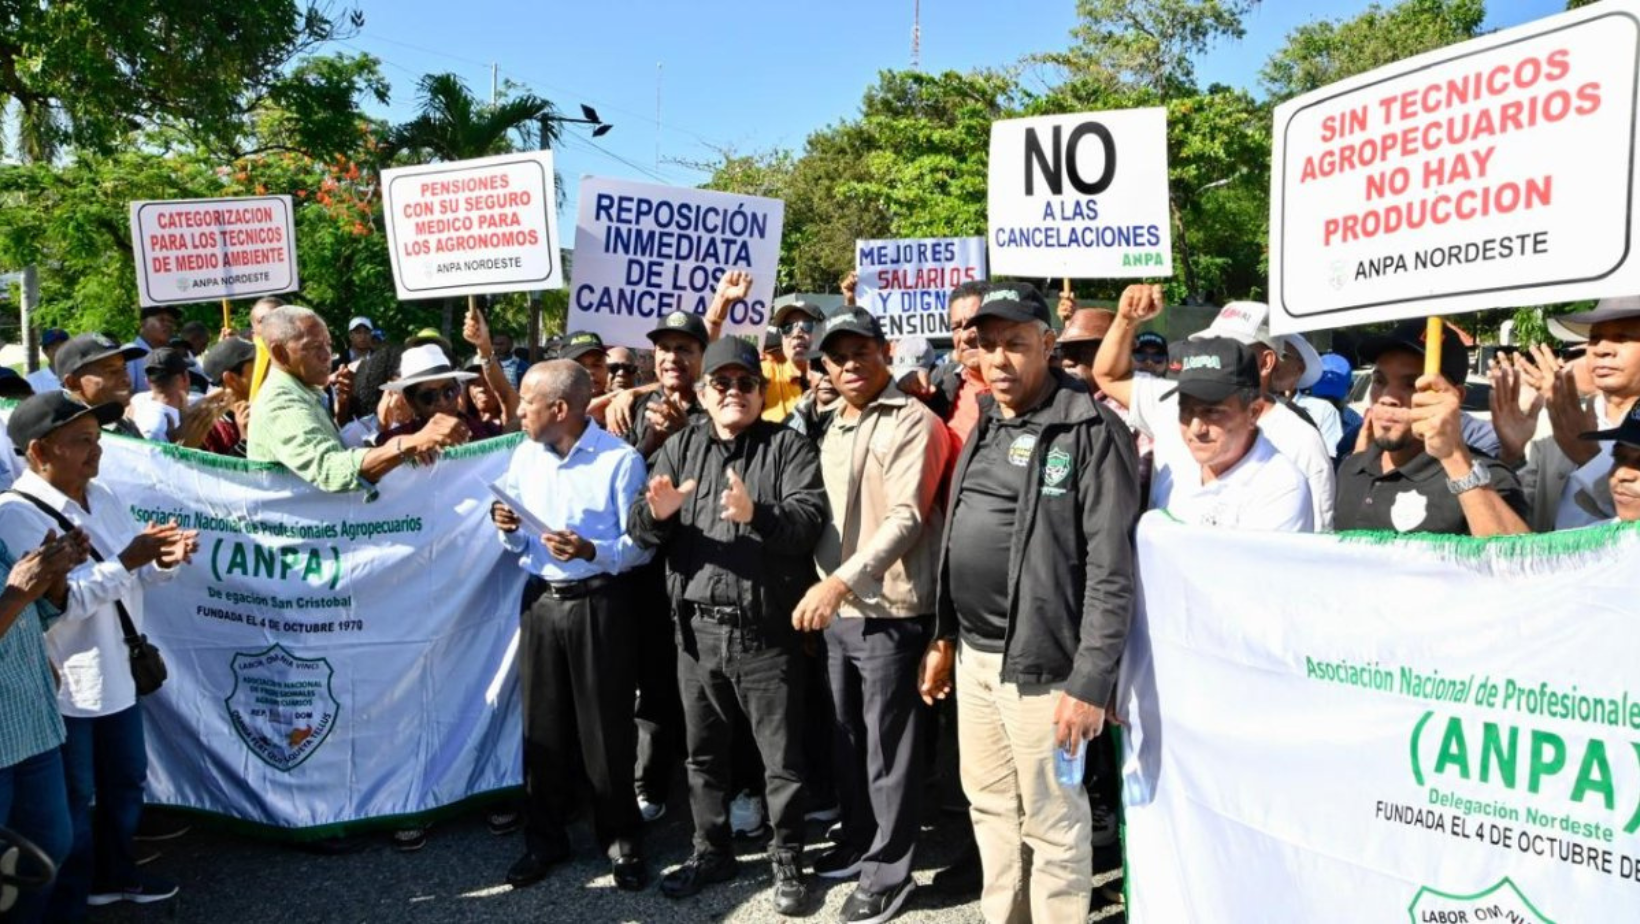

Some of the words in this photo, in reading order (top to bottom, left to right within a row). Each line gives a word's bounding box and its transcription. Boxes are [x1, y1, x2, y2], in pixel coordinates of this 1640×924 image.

[1320, 105, 1368, 143] SIN
[1379, 48, 1571, 125] TECNICOS
[1300, 82, 1602, 184] AGROPECUARIOS
[1024, 121, 1116, 196] NO
[420, 174, 510, 198] PENSIONES
[1365, 166, 1410, 201] NO
[1422, 146, 1496, 189] HAY
[403, 202, 434, 218] CON
[439, 199, 460, 214] SU
[464, 191, 532, 212] SEGURO
[595, 193, 768, 239] REPOSICIÓN
[1043, 200, 1056, 221] A
[1060, 199, 1098, 221] LAS
[1323, 175, 1552, 247] PRODUCCION
[157, 207, 273, 230] CATEGORIZACION
[415, 217, 473, 236] MEDICO
[478, 212, 521, 229] PARA
[150, 233, 188, 251] PARA
[191, 231, 218, 249] LOS
[220, 227, 283, 247] TECNICOS
[404, 240, 431, 257] LOS
[435, 230, 539, 254] AGRONOMOS
[604, 225, 753, 267] INMEDIATA
[995, 225, 1160, 248] CANCELACIONES
[152, 256, 172, 273] DE
[175, 253, 218, 271] MEDIO
[223, 247, 285, 268] AMBIENTE
[436, 262, 462, 274] ANPA
[464, 256, 522, 271] NORDESTE
[859, 242, 956, 266] MEJORES
[1122, 252, 1164, 267] ANPA
[1354, 253, 1408, 281] ANPA
[1414, 231, 1549, 271] NORDESTE
[192, 277, 219, 289] ANPA
[221, 271, 270, 286] NORDESTE
[625, 259, 664, 289] DE
[877, 292, 893, 313] Y
[901, 291, 948, 313] DIGN
[876, 313, 950, 336] ENSION
[340, 514, 423, 542] Agropecuarios
[210, 538, 343, 590] (ANPA)
[271, 596, 293, 610] San
[296, 594, 352, 609] Cristobal
[196, 605, 243, 623] FUNDADA
[246, 615, 257, 626] EL
[259, 618, 266, 628] 4
[268, 619, 280, 631] DE
[283, 622, 335, 634] OCTUBRE
[1305, 655, 1394, 693] Asociación
[1399, 666, 1475, 703] Nacional
[1474, 674, 1499, 709] de
[1502, 679, 1640, 731] Profesionale
[1428, 787, 1519, 822] Delegación
[1525, 807, 1614, 843] Nordeste
[1375, 800, 1446, 833] FUNDADA
[1450, 815, 1471, 839] EL
[1475, 822, 1485, 842] 4
[1489, 824, 1512, 848] DE
[1517, 831, 1613, 875] OCTUBRE
[1421, 910, 1469, 924] LABOR
